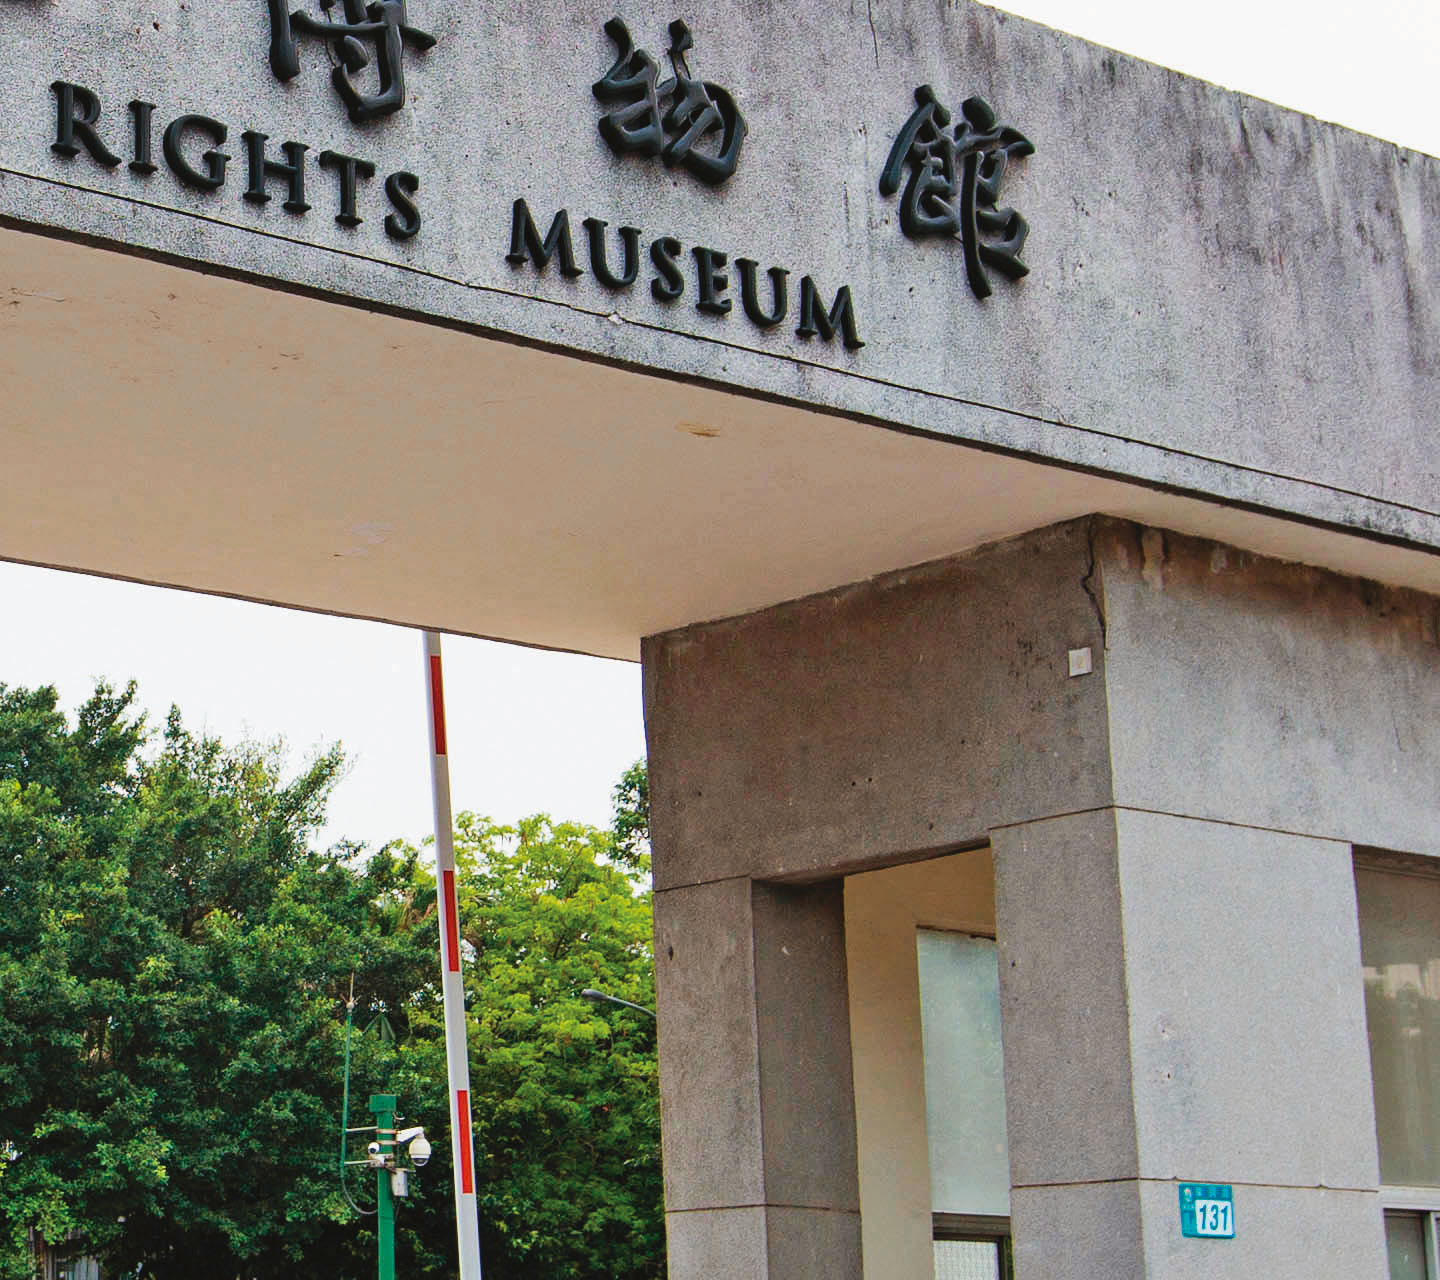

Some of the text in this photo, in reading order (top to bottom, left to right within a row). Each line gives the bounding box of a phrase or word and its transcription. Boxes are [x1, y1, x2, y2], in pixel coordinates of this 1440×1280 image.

[49, 80, 424, 240] RIGHTS
[507, 197, 867, 349] MUSEUM
[1199, 1203, 1229, 1232] 131
